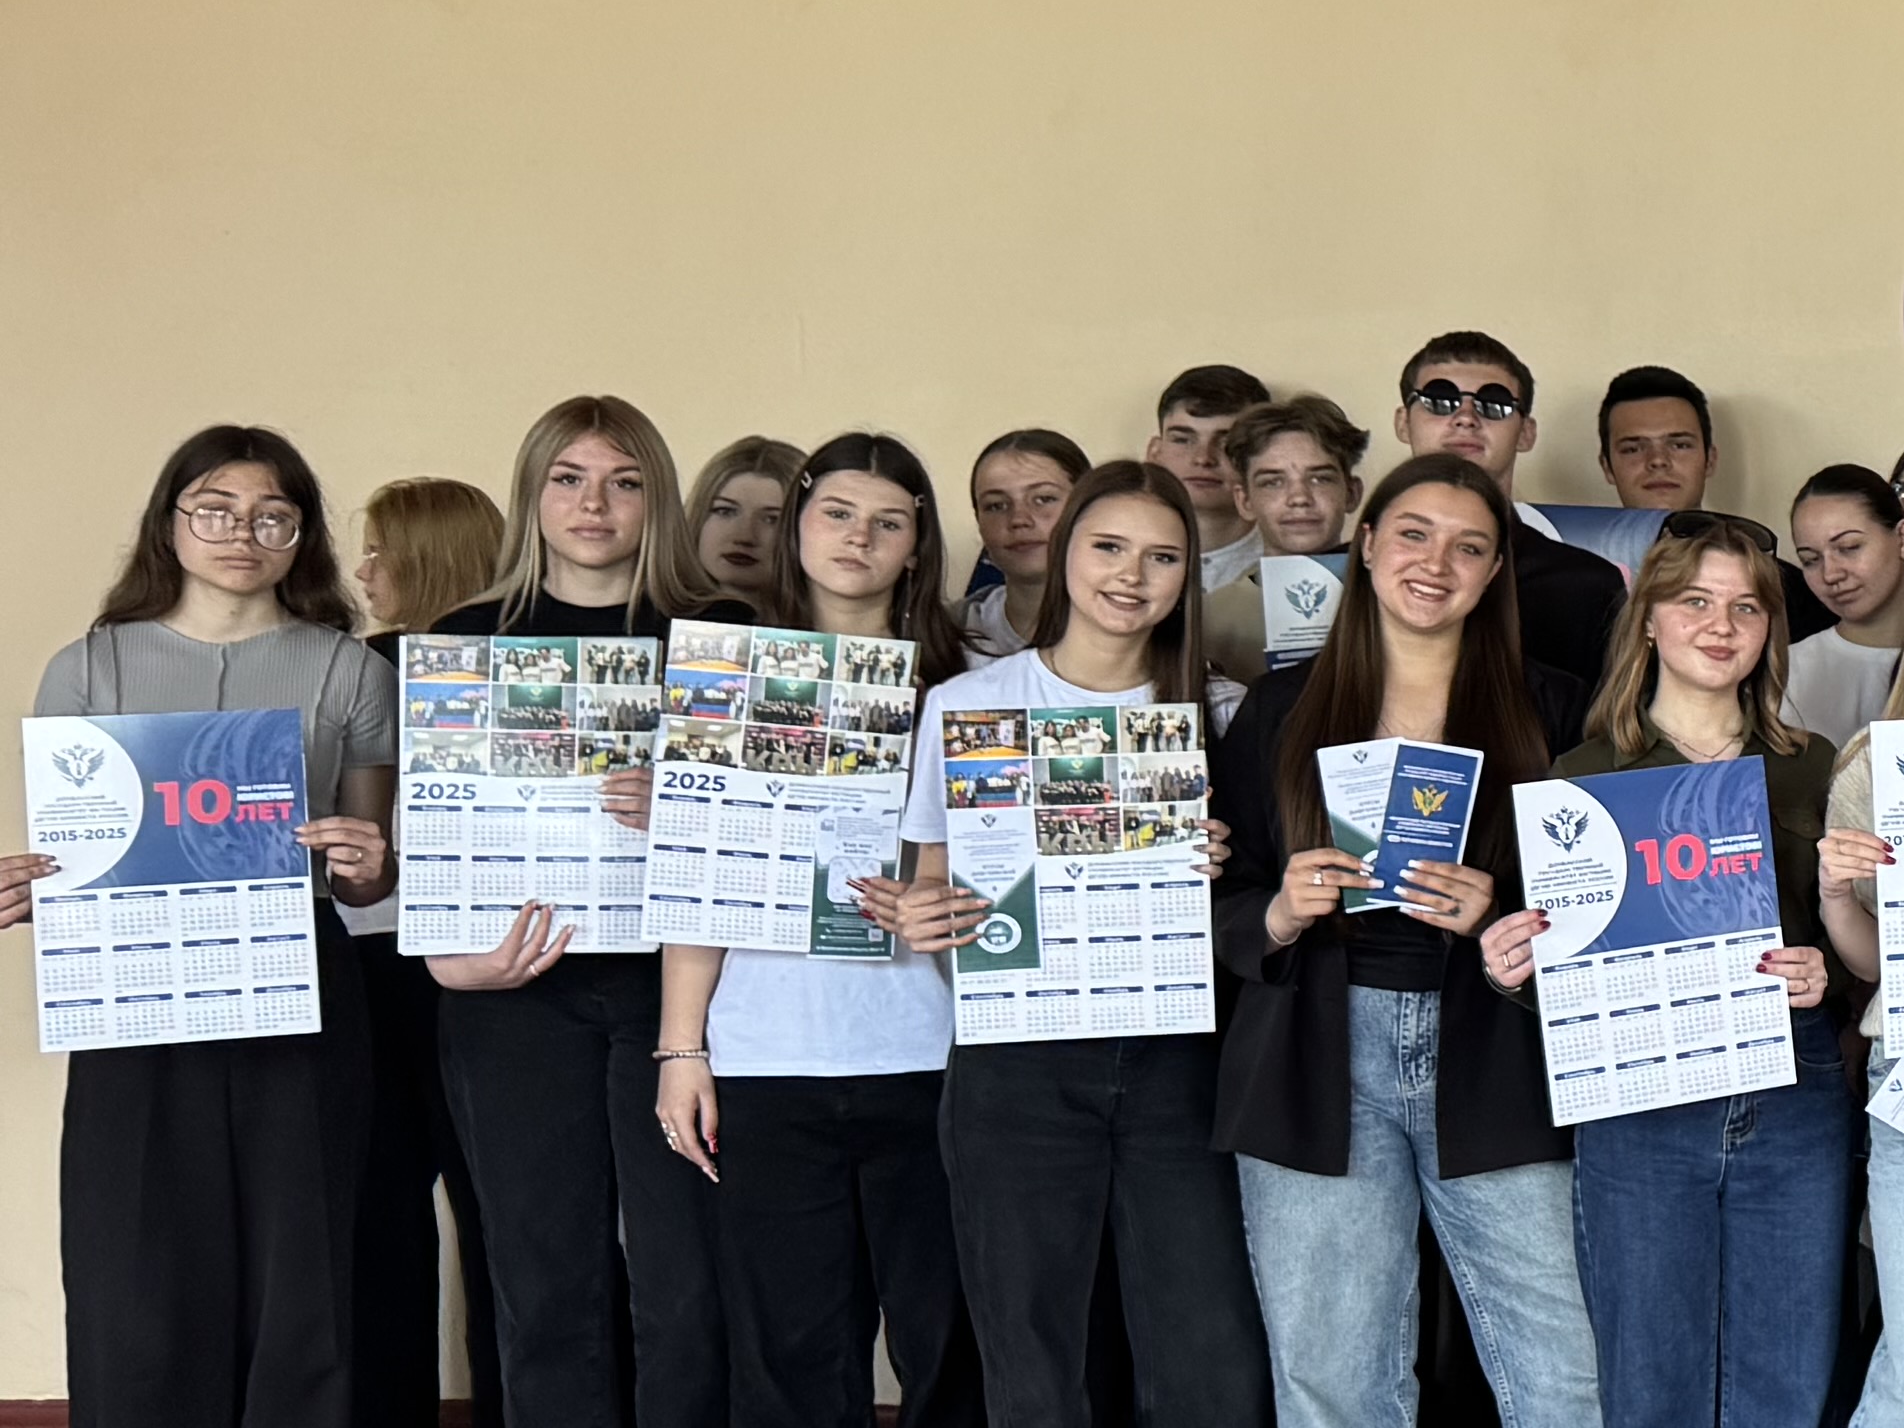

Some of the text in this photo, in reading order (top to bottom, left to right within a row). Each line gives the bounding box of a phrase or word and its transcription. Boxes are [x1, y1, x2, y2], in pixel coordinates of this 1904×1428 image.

[411, 783, 477, 800] 2025
[661, 771, 727, 793] 2025
[153, 779, 232, 826] 10
[234, 802, 295, 822] ЛЕТ
[38, 827, 128, 843] 2015-2025
[1634, 833, 1708, 885] 10
[1709, 852, 1763, 877] ЛЕТ
[1535, 889, 1615, 910] 2015-2025
